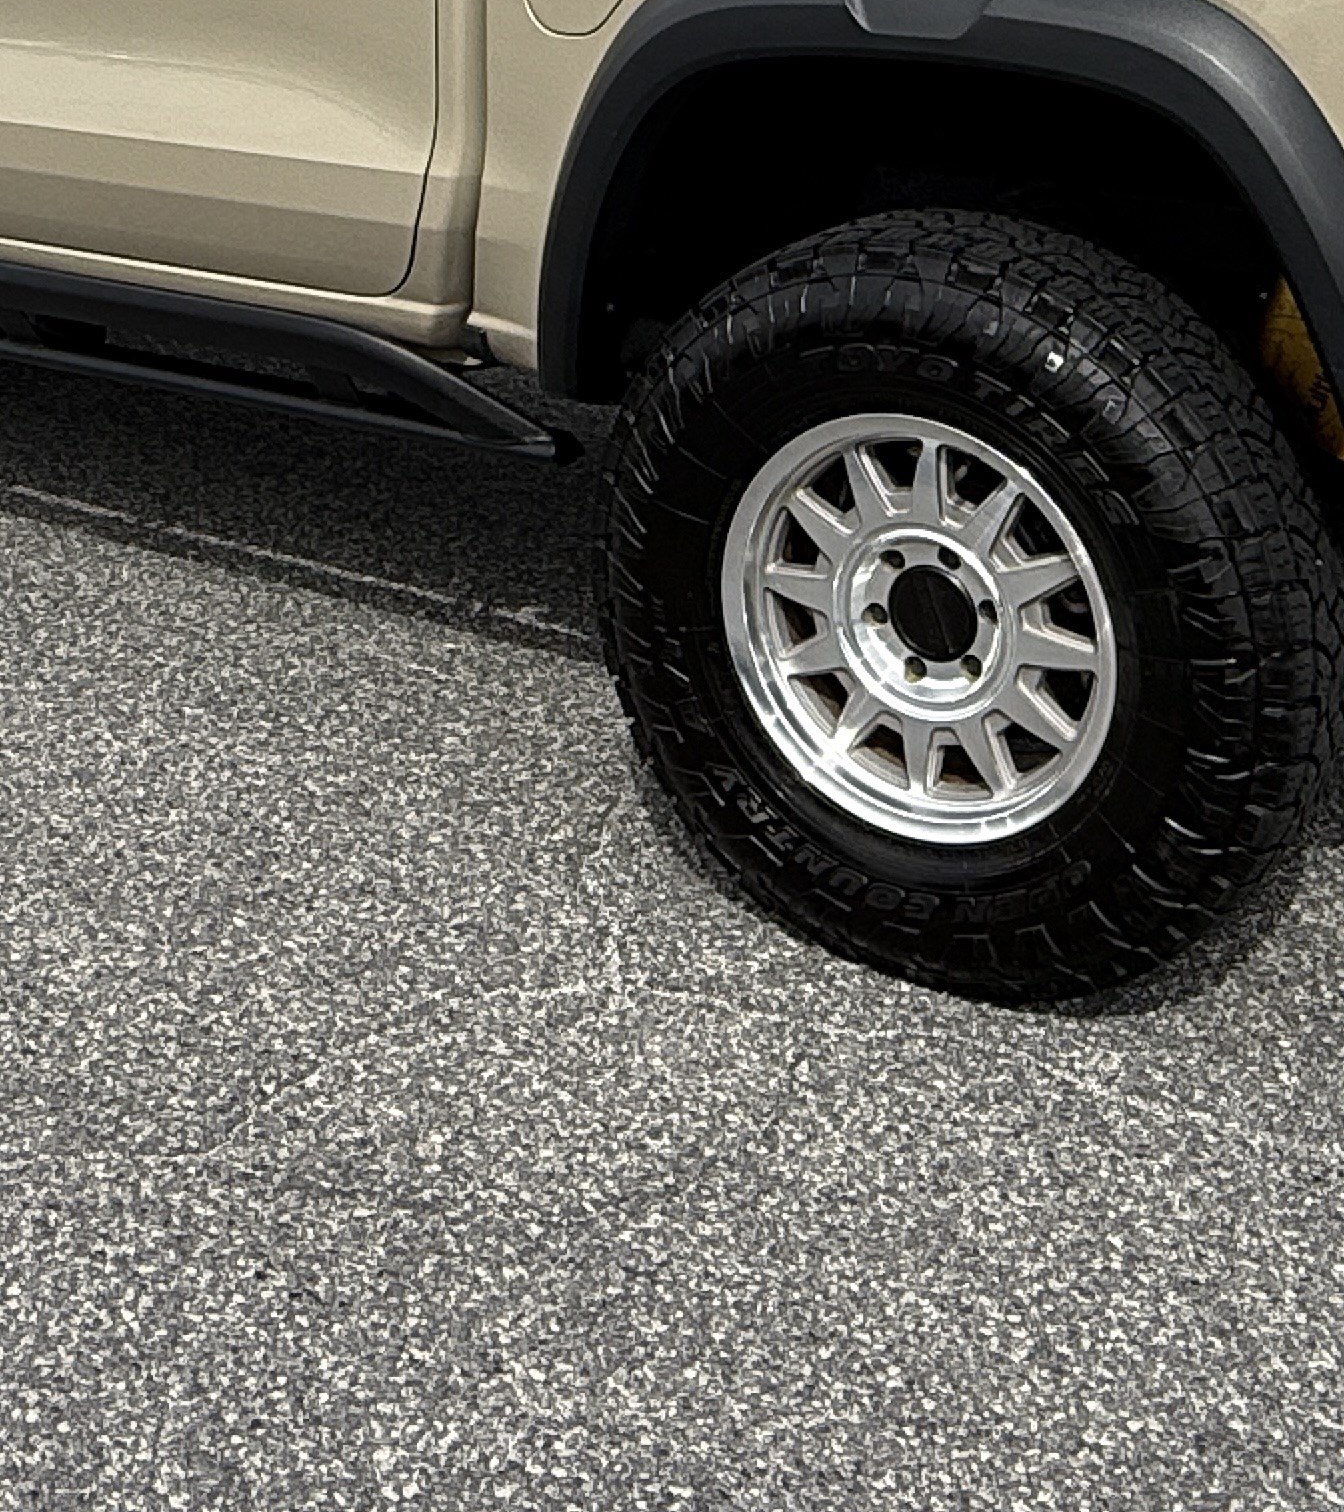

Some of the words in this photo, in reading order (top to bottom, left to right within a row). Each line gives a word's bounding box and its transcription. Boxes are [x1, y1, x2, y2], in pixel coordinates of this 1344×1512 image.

[797, 340, 960, 381] TOYO
[975, 367, 1142, 527] TIRES
[703, 760, 940, 920] COUNTRY
